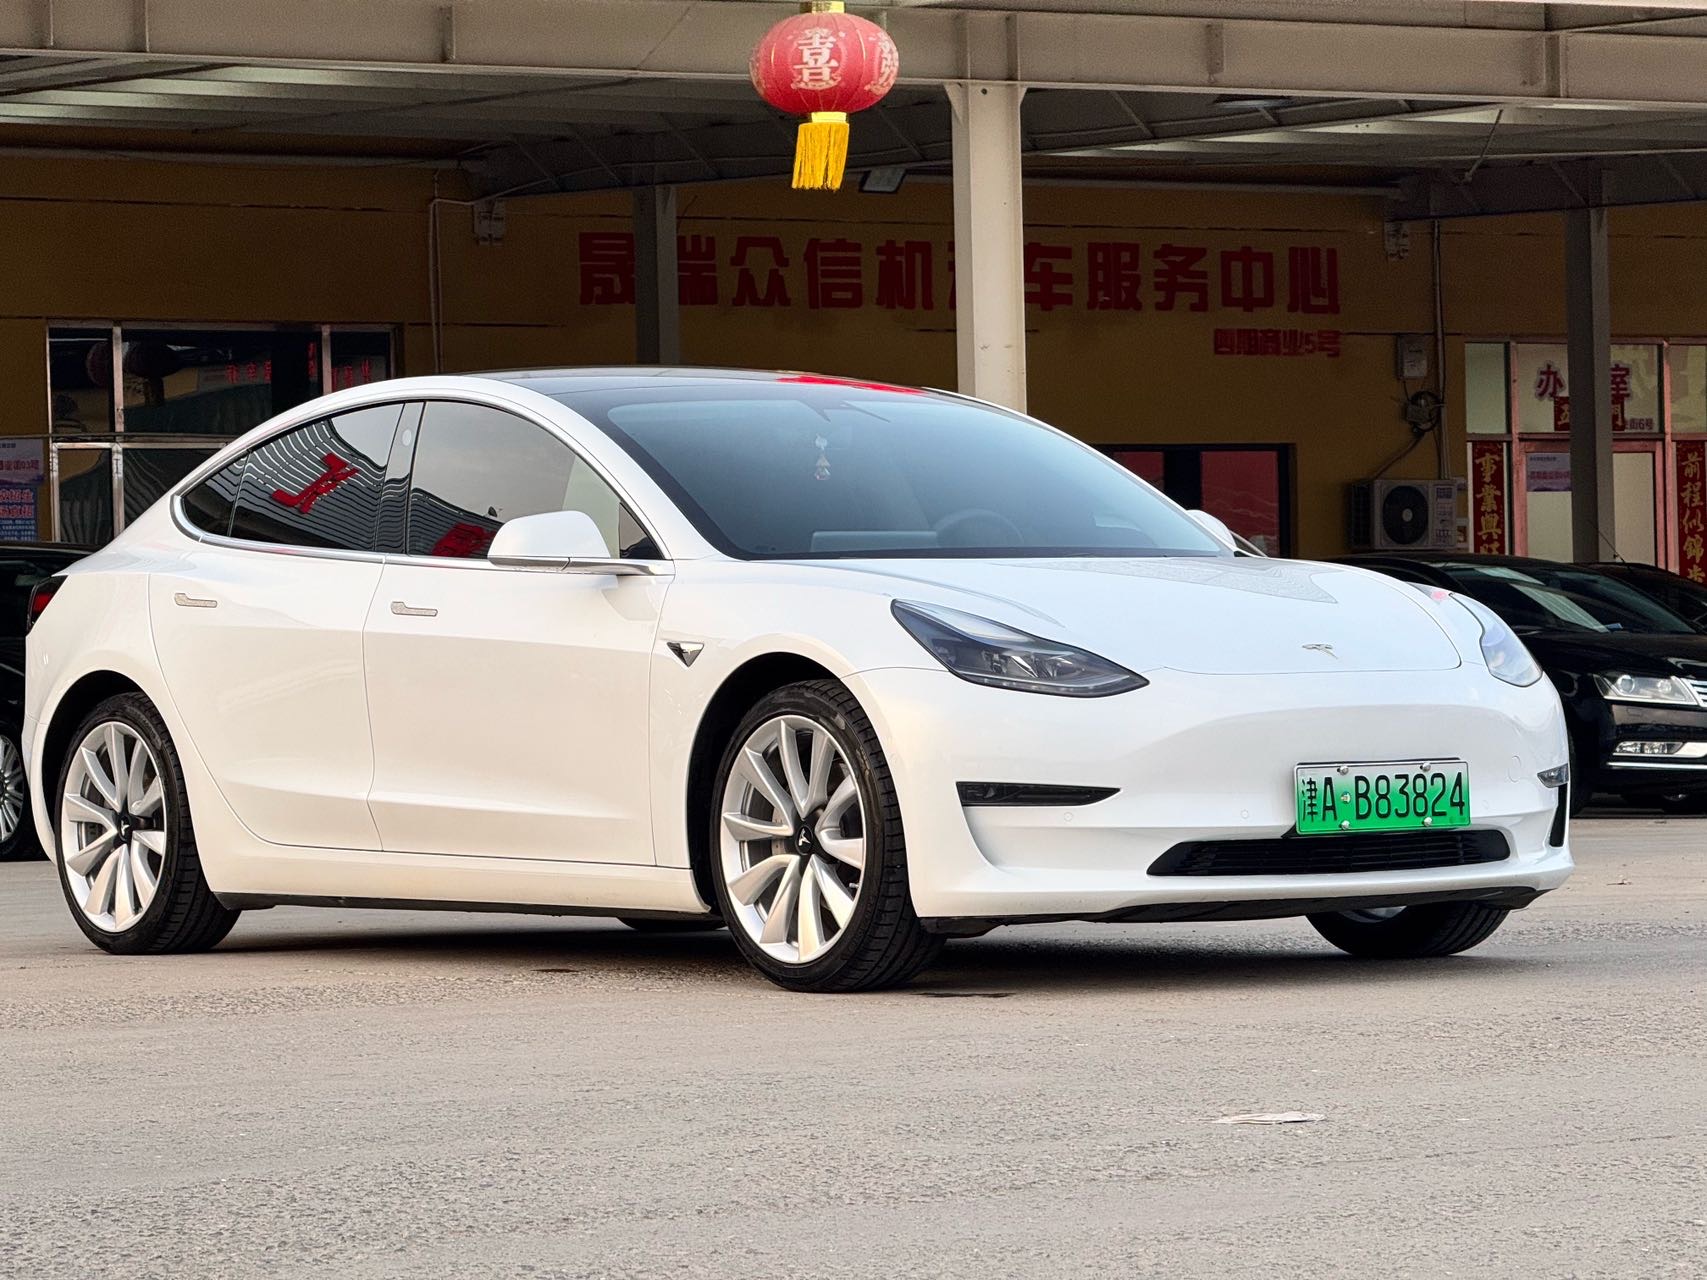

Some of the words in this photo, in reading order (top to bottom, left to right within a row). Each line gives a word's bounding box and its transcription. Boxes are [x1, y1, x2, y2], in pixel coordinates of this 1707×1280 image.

[793, 32, 839, 82] 喜
[579, 231, 1340, 314] 晟瑞众信机车服务中心
[1537, 363, 1630, 401] 办室
